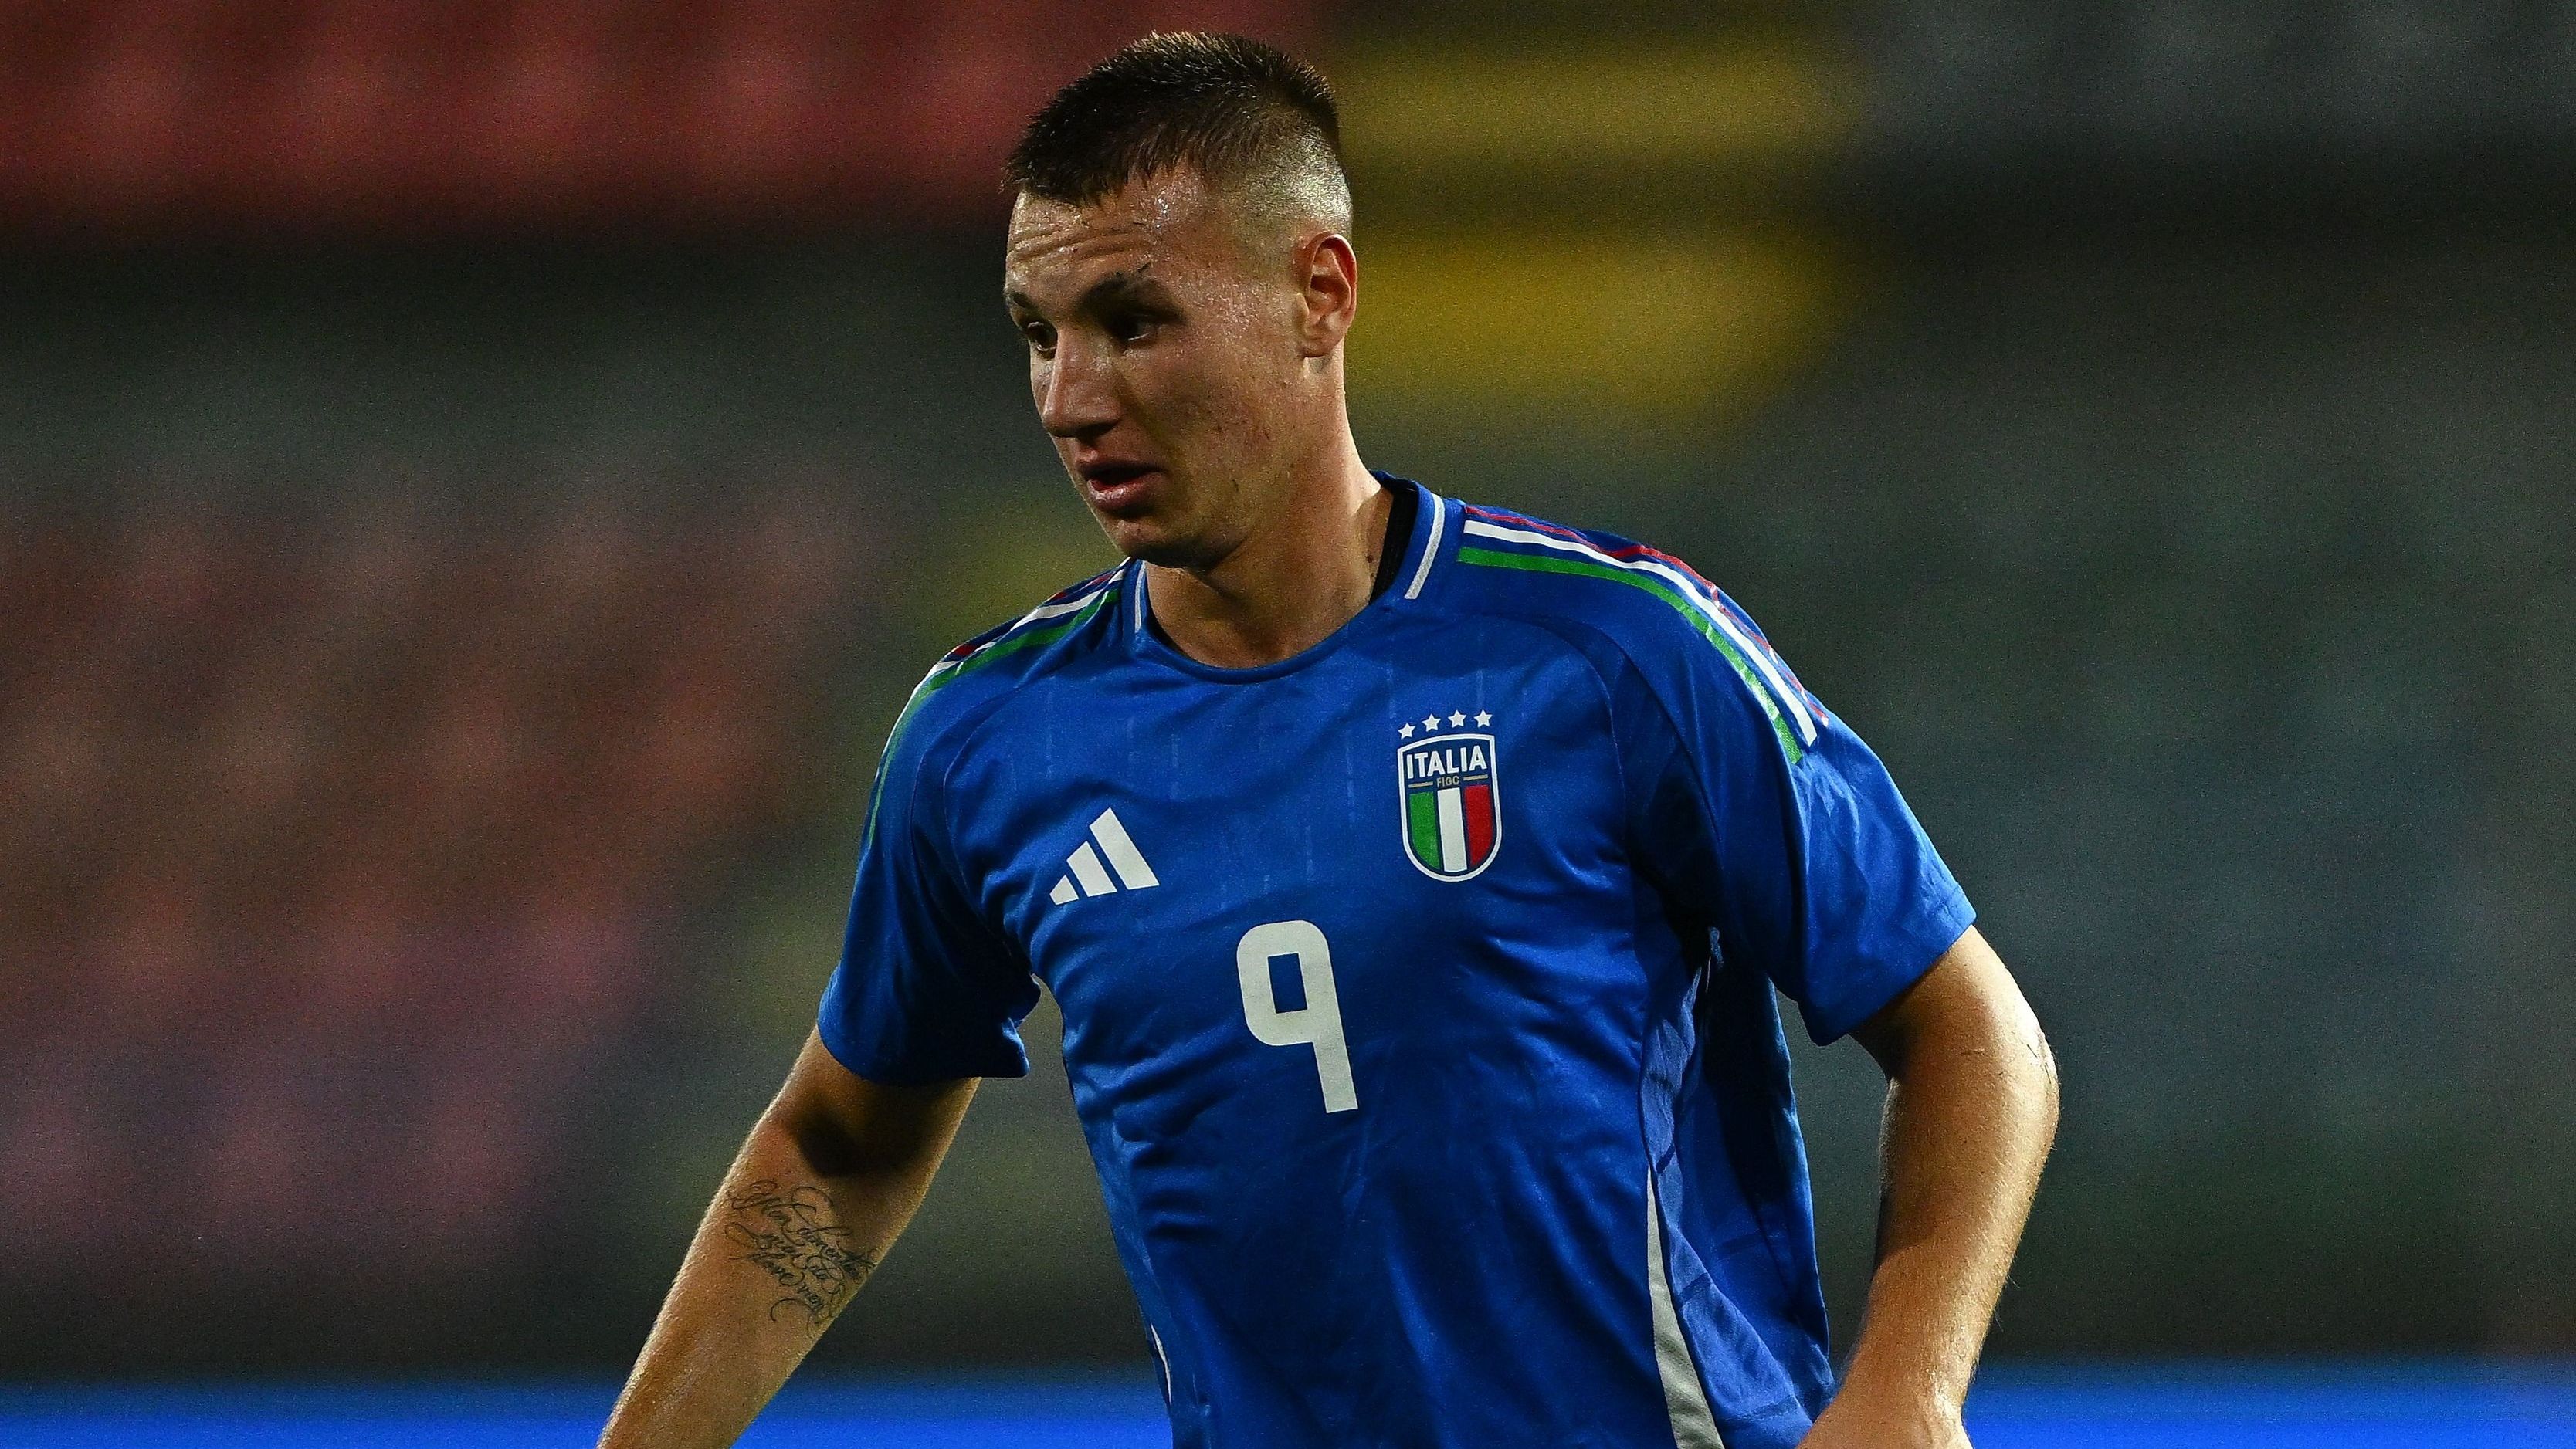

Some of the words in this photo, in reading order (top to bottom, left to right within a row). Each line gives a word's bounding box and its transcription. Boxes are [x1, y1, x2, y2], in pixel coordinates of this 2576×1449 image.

[1406, 745, 1488, 779] ITALIA
[1436, 775, 1460, 788] FIGC
[1236, 919, 1358, 1113] 9
